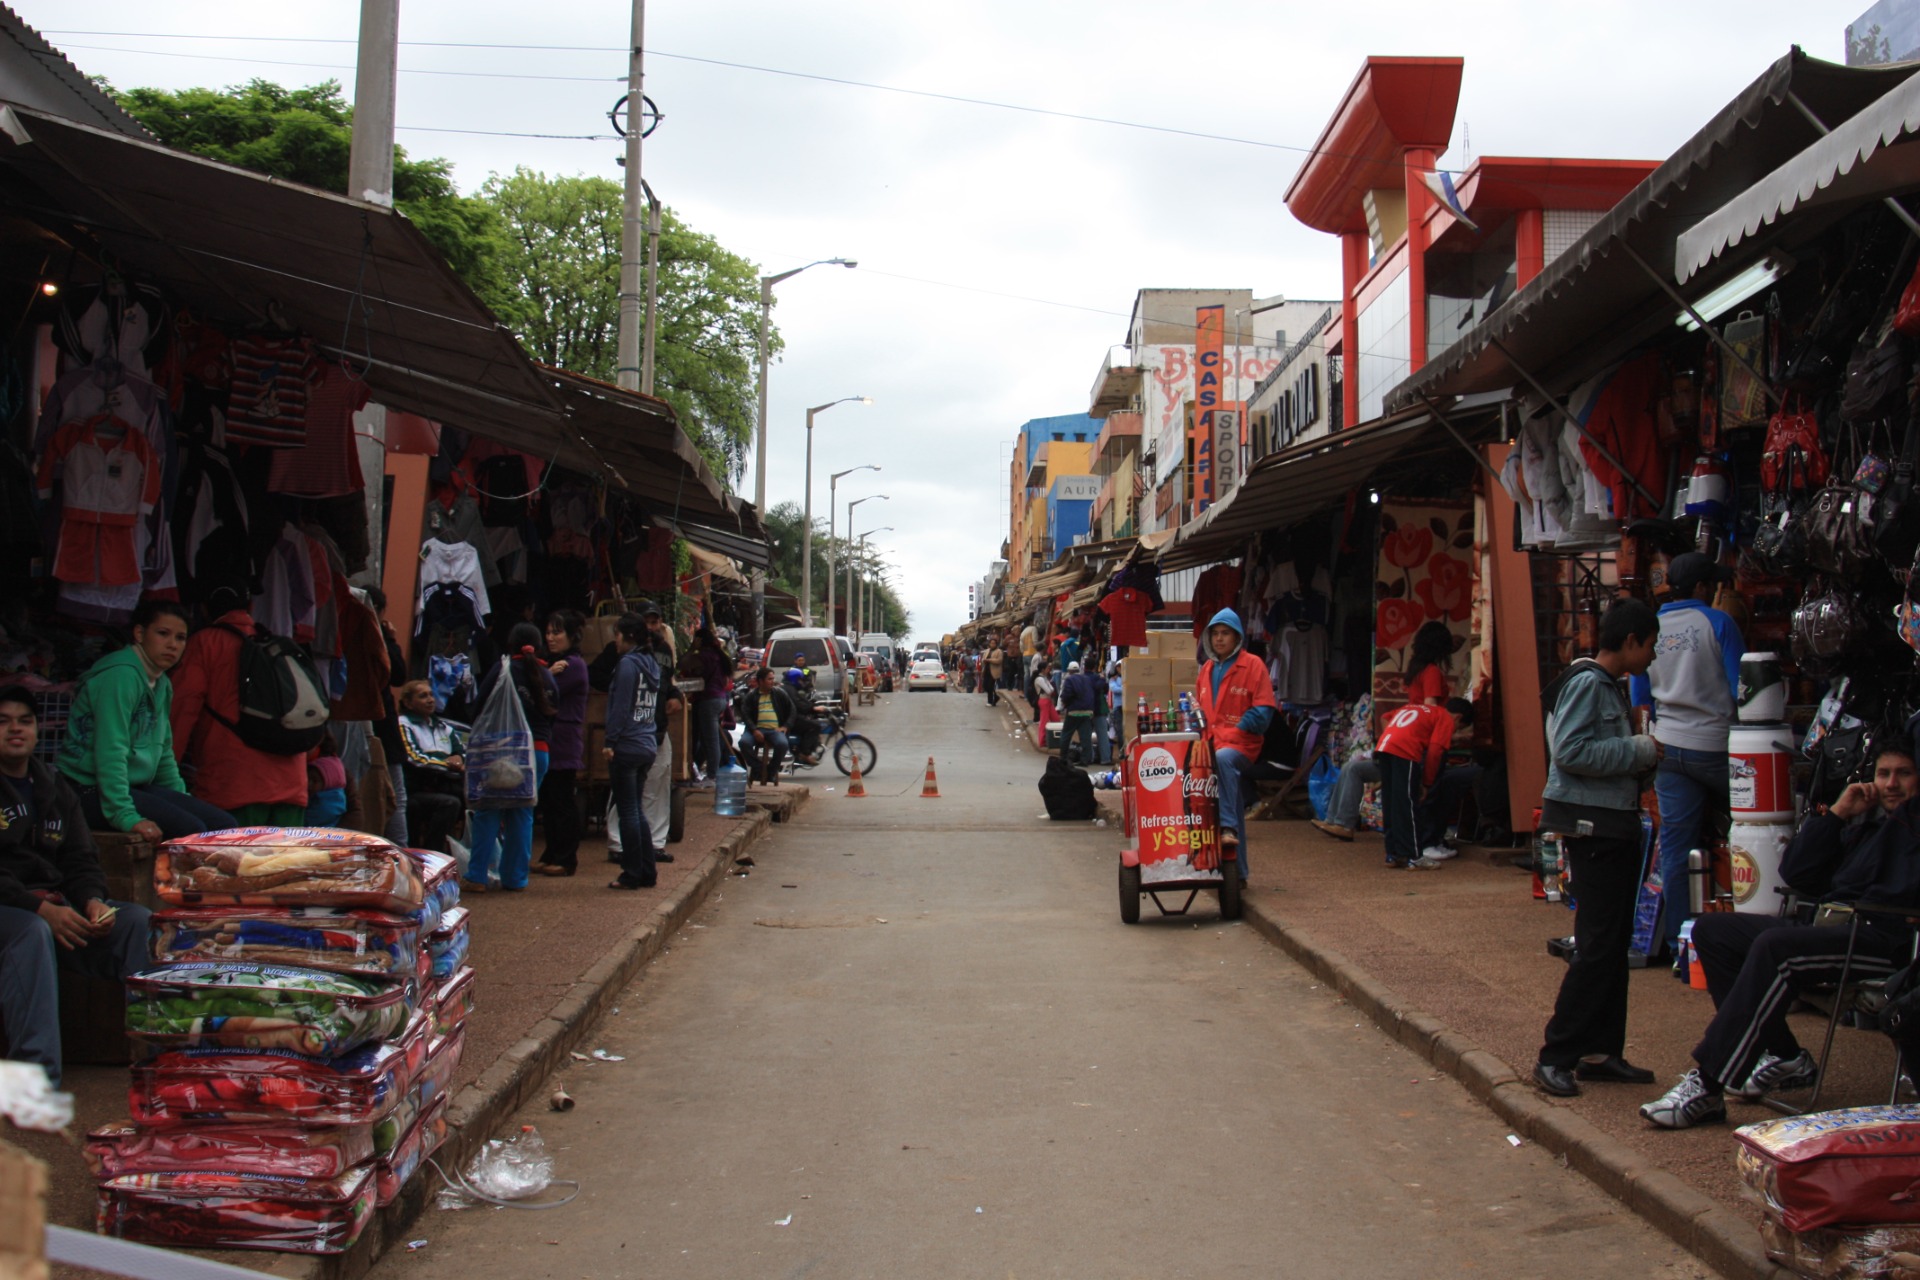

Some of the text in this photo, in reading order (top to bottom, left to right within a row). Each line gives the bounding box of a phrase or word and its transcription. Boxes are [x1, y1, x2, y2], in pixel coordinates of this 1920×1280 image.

[1269, 362, 1319, 454] PALOMA
[1063, 485, 1098, 495] AUR
[1387, 708, 1419, 729] 10
[1141, 755, 1170, 768] Coca-Cola
[1145, 766, 1175, 777] 1.000
[1141, 812, 1202, 829] Refrescate
[1153, 824, 1216, 851] y Seguí
[1732, 866, 1756, 883] KOL
